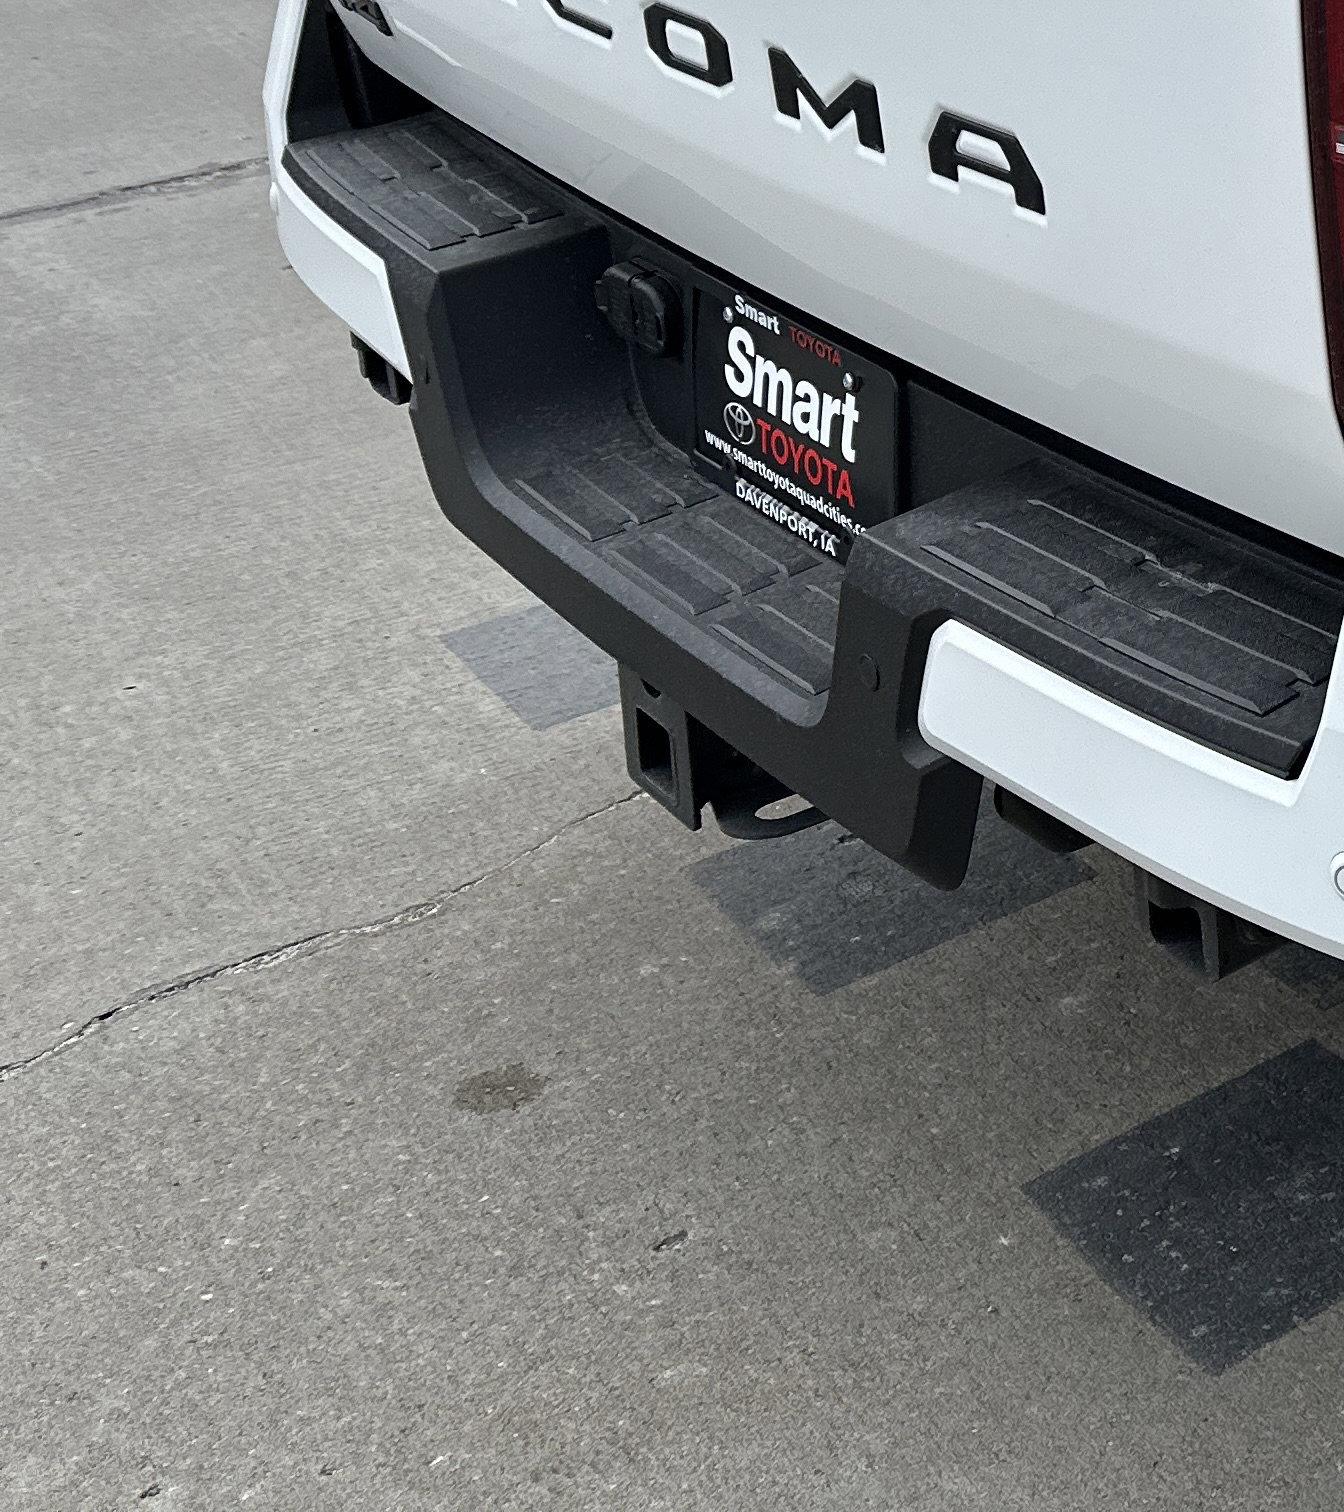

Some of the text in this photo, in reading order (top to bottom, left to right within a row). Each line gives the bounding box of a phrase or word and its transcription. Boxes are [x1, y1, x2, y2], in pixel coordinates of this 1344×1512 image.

[734, 294, 843, 367] Smart TOYOTA
[724, 325, 860, 464] Smart
[755, 418, 856, 509] TOYOTA
